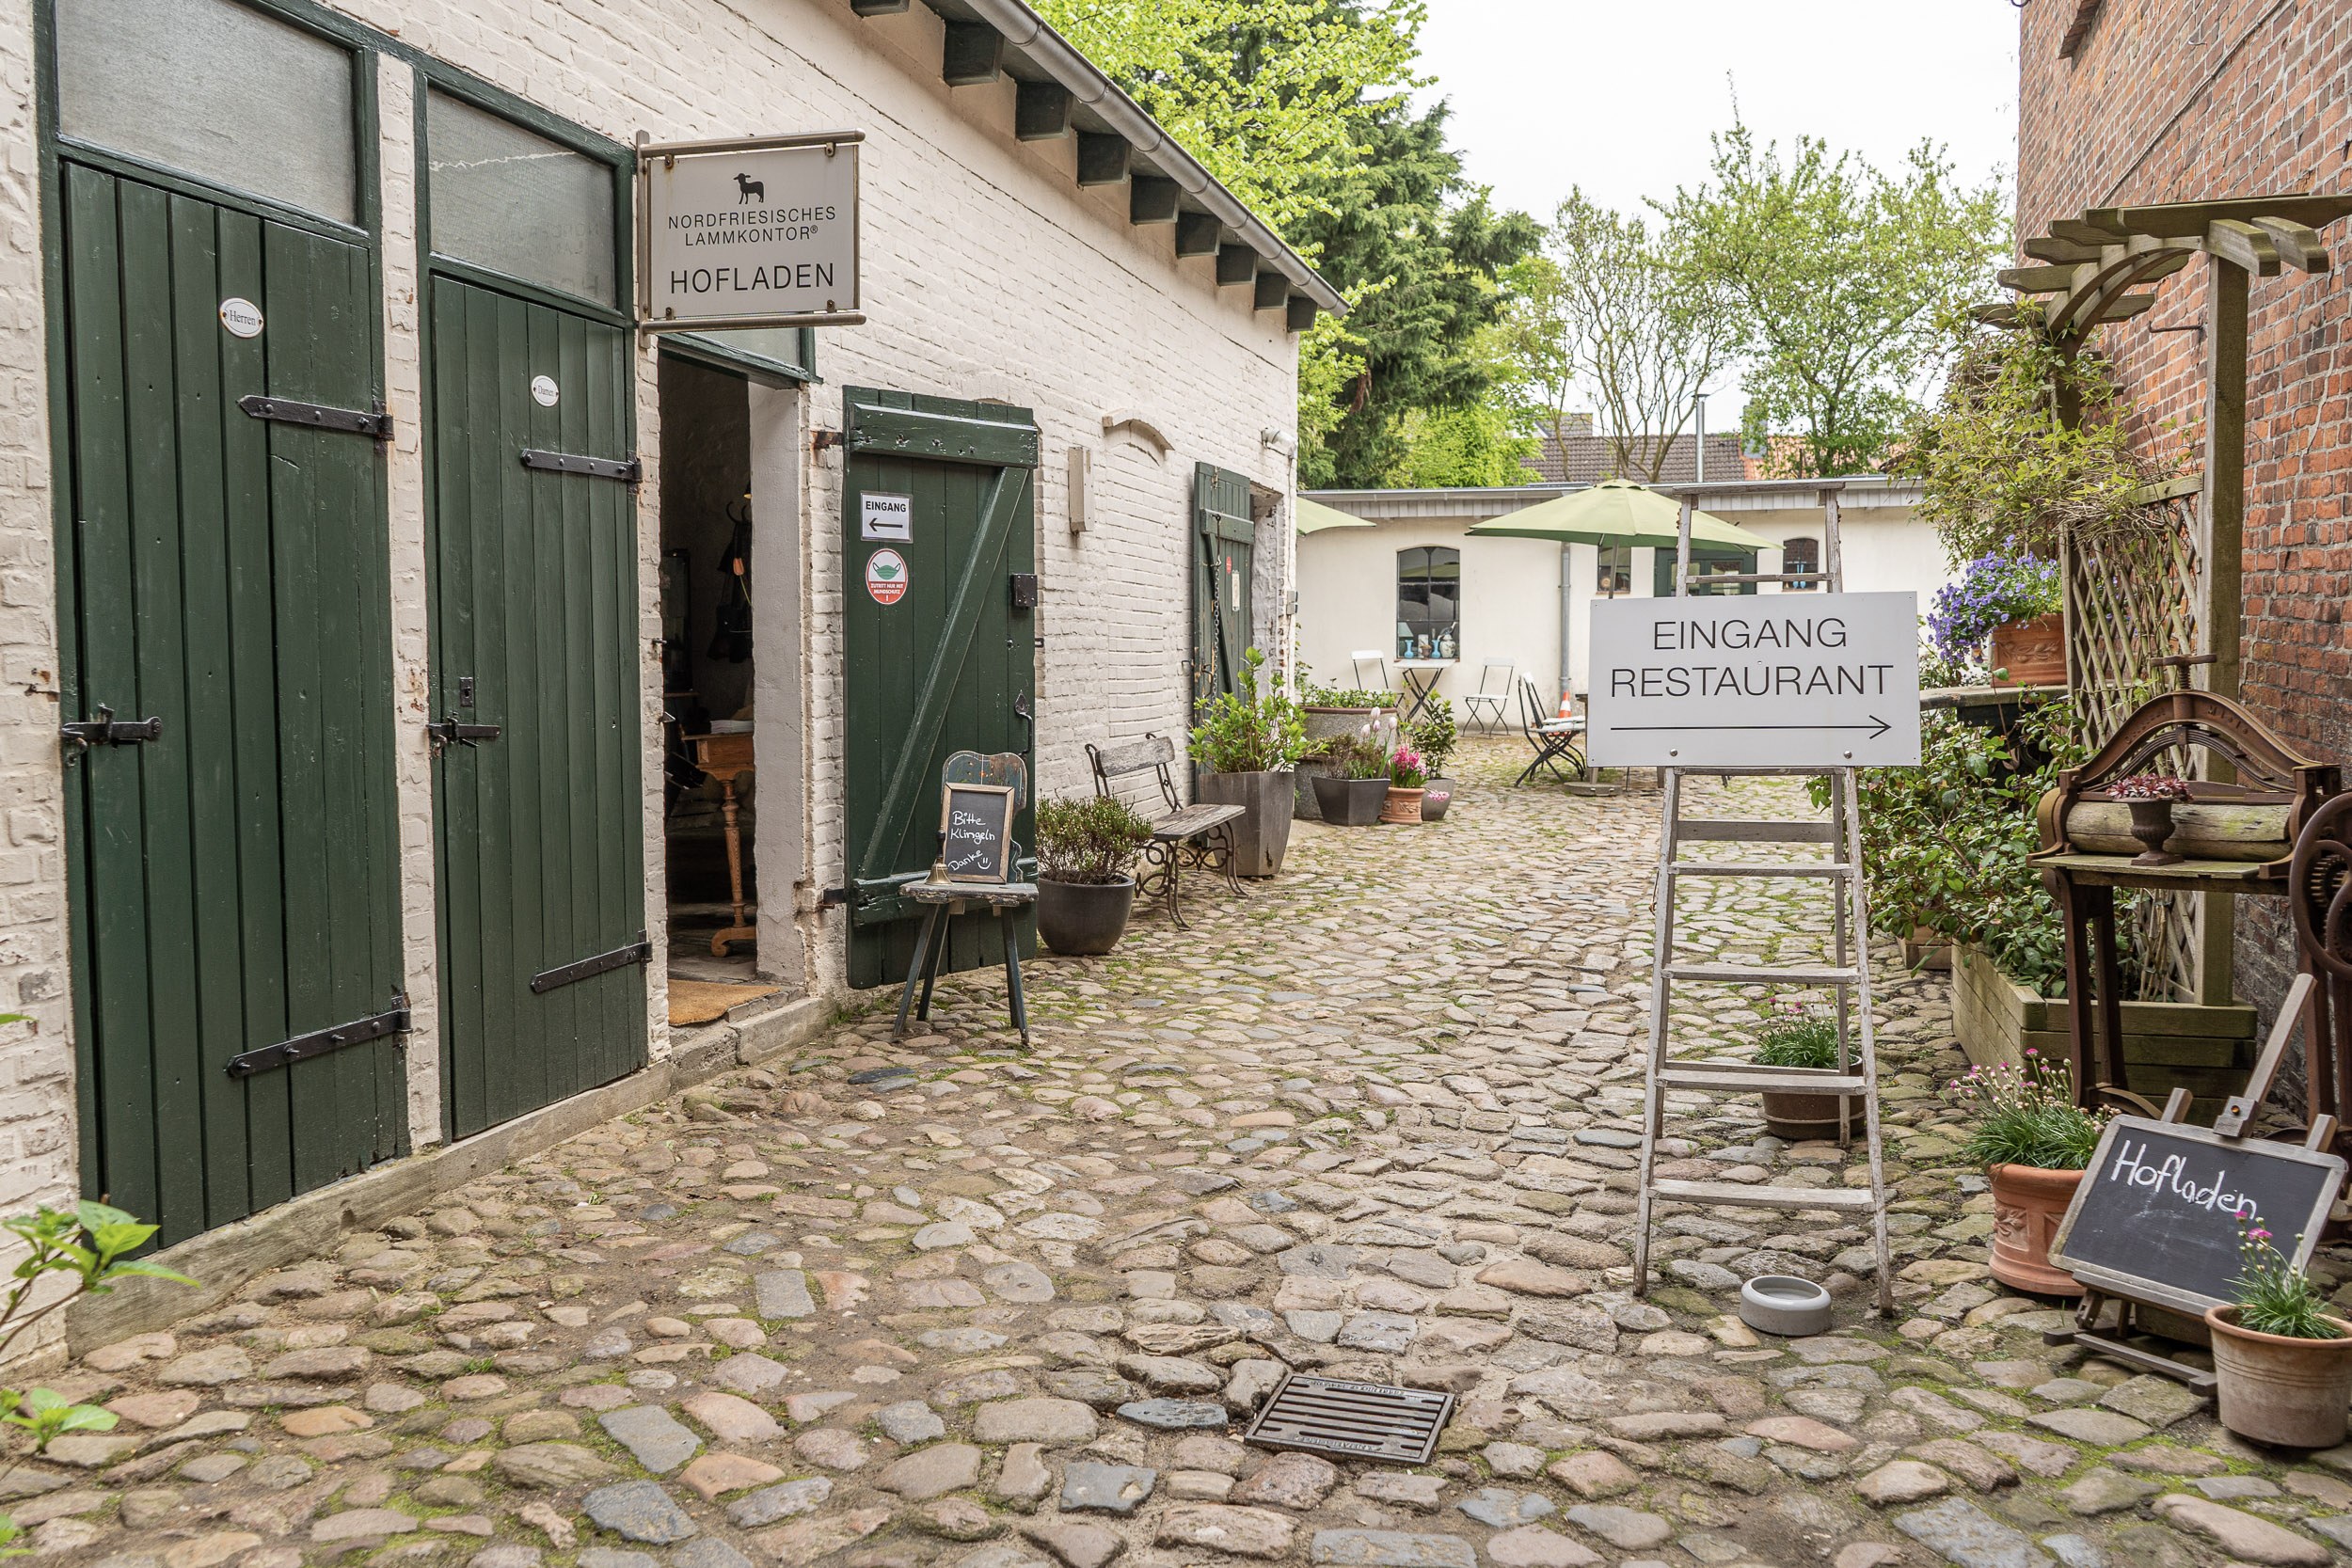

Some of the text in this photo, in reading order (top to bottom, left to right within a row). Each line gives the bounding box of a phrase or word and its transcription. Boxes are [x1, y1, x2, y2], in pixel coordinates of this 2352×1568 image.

[668, 206, 836, 230] NORDFRIESISCHES
[671, 262, 834, 294] HOFLADEN
[229, 309, 257, 326] Herren
[866, 500, 907, 513] EINGANG
[1653, 617, 1847, 651] EINGANG
[1610, 663, 1895, 698] RESTAURANT
[952, 810, 986, 826] Bitte
[950, 828, 995, 845] Klingeln
[947, 849, 983, 871] Danke
[2110, 1139, 2258, 1220] Hofladen
